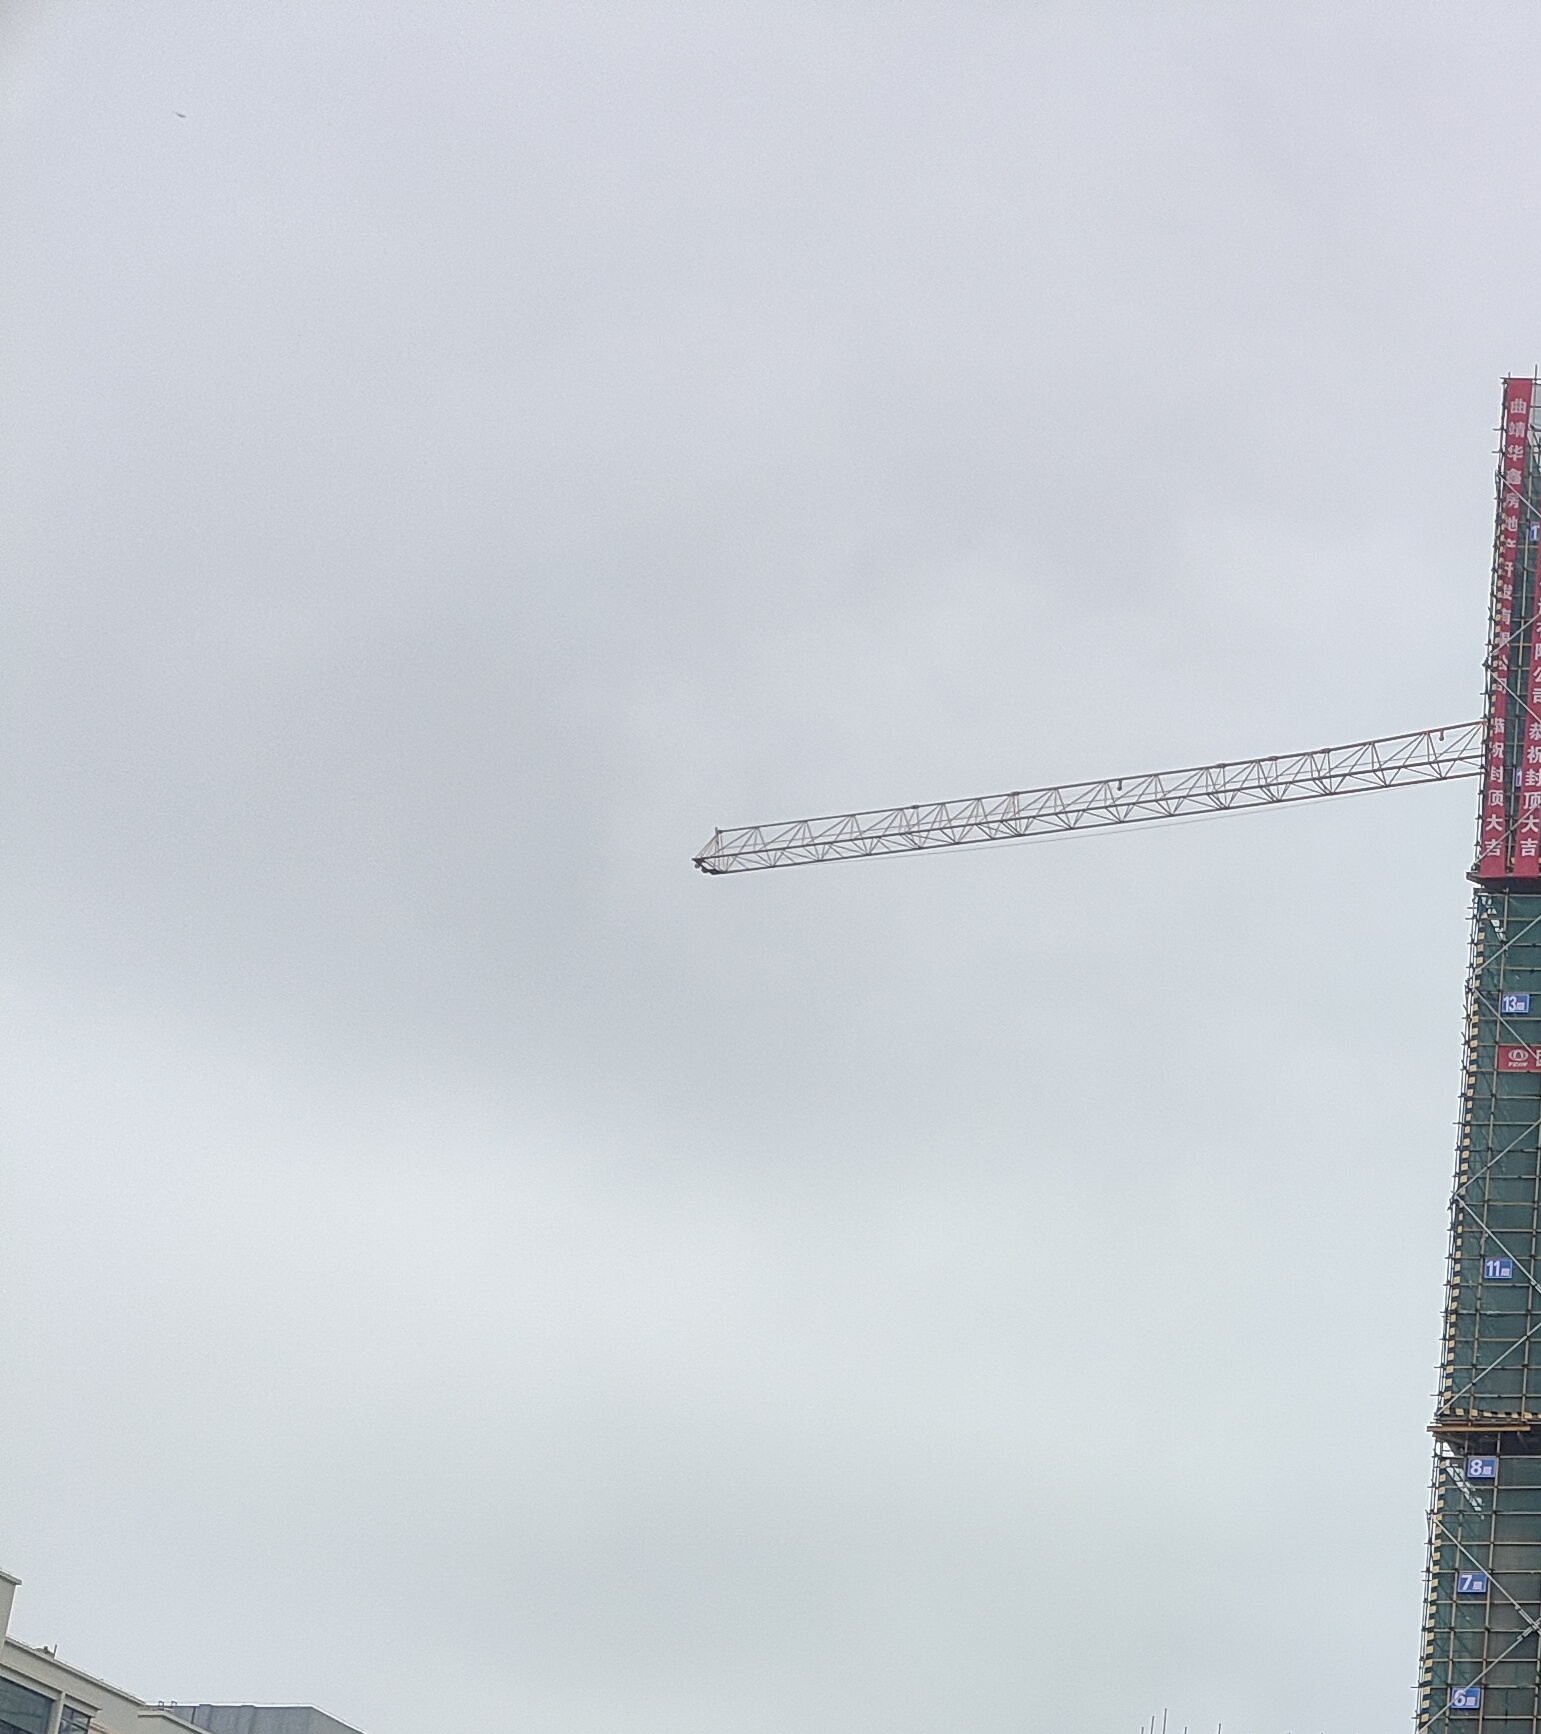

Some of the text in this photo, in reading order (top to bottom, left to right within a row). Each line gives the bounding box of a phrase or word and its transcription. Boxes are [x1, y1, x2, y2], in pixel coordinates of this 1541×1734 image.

[1502, 995, 1525, 1011] 13层
[1486, 1261, 1509, 1276] 11层
[1469, 1460, 1492, 1475] 8层
[1461, 1575, 1482, 1590] 7层
[1453, 1690, 1476, 1706] 6层
